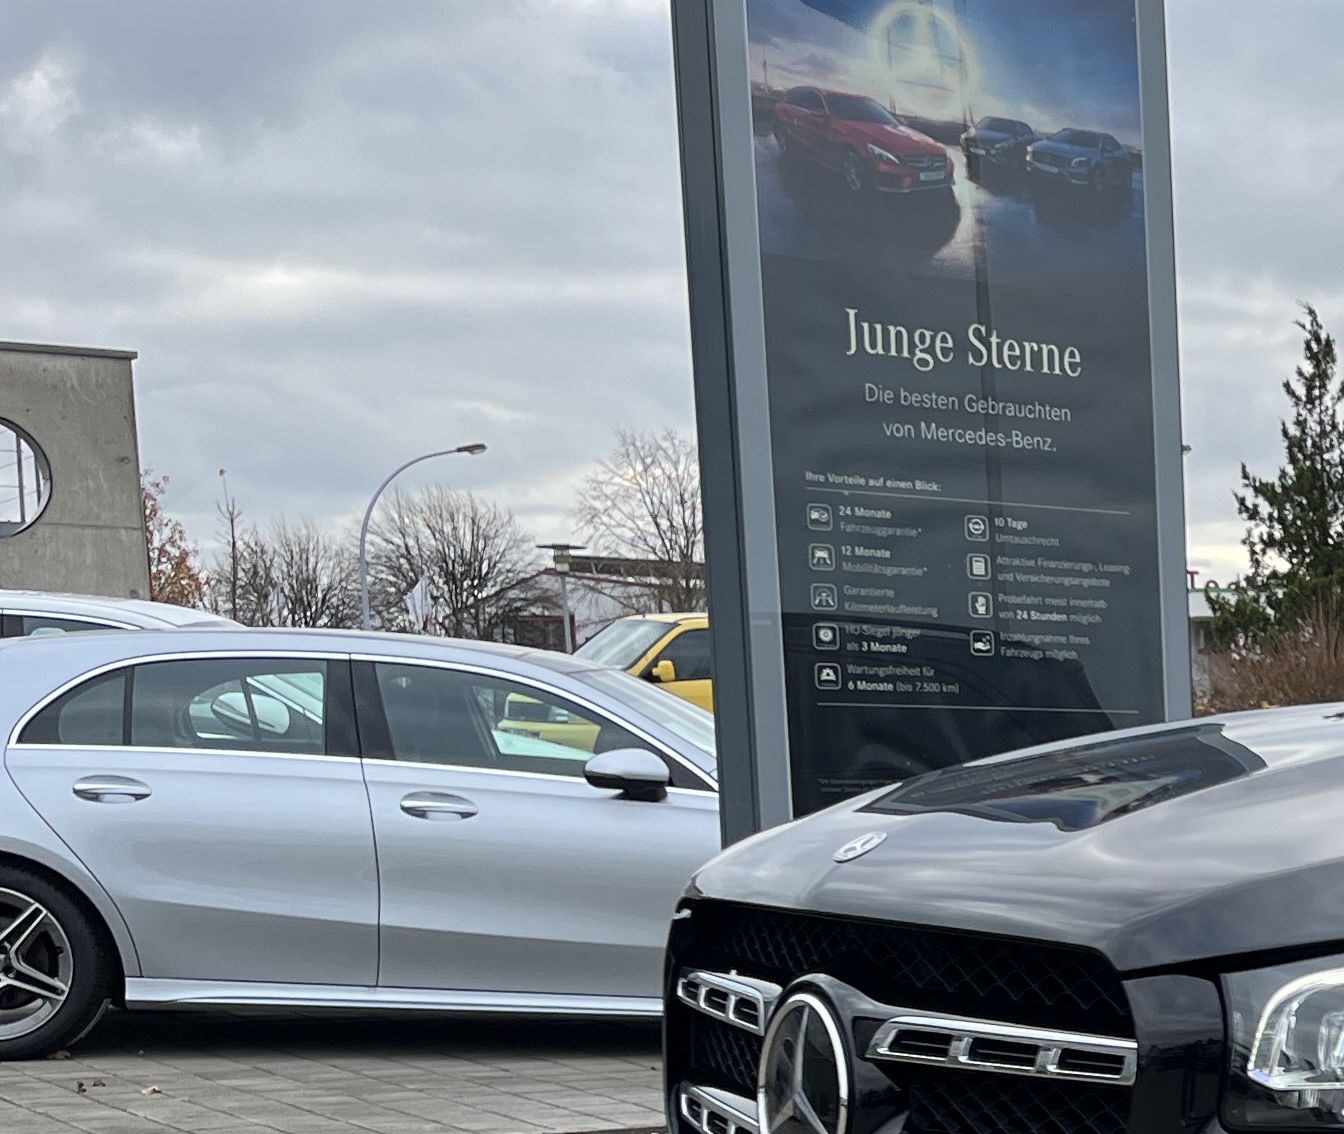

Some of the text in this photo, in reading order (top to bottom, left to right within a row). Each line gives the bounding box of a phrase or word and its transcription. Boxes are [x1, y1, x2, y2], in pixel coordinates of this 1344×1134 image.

[844, 307, 1083, 377] Junge Sterne
[865, 382, 1072, 422] Die besten Gebrauchten
[883, 421, 1058, 453] von Mercedes-Benz.
[805, 471, 942, 492] Ihre Vorteile auf einen Blick:
[839, 506, 892, 519] 24 Monate
[994, 516, 1028, 531] 10 Tage
[841, 546, 891, 559] 12 Monate
[996, 571, 1014, 582] und
[843, 585, 895, 598] Garantierte
[998, 610, 1015, 619] von
[1016, 608, 1028, 620] 24
[1030, 609, 1068, 622] Stunden
[846, 641, 908, 653] als 3 Monate
[1000, 646, 1079, 662] Fahrzeugs möglich
[922, 666, 935, 676] für
[848, 680, 960, 694] 6 Monate (bis 7.500 km)
